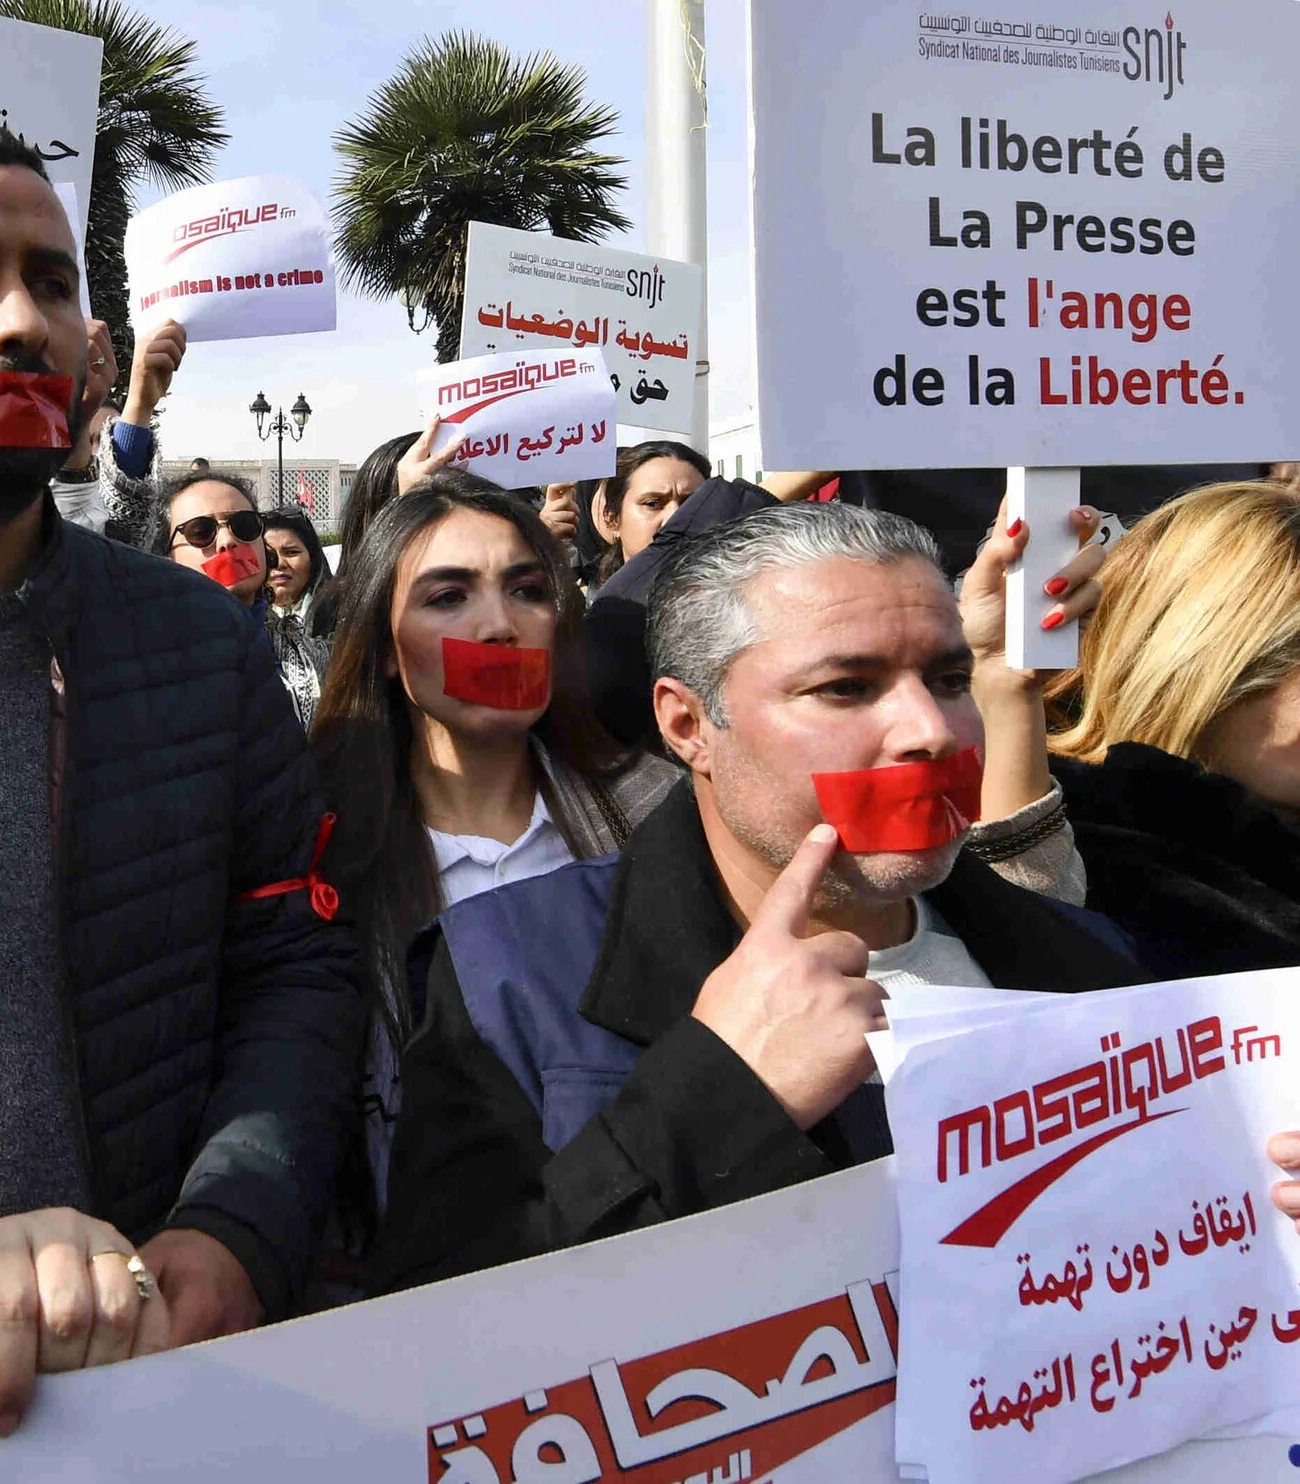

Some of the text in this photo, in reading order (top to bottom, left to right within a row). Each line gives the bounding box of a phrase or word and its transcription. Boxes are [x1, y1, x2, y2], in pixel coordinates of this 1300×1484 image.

[918, 37, 1120, 73] Syndicat National des Journalistes Tunisiens
[1035, 24, 1081, 45] الوطنية
[1122, 10, 1187, 101] snjt
[871, 112, 1226, 183] La liberté de
[928, 196, 1196, 256] La Presse
[216, 275, 232, 292] is
[235, 272, 262, 290] not
[264, 273, 274, 287] a
[626, 264, 665, 309] snjt
[916, 277, 1191, 342] est l'ange
[477, 301, 689, 361] تسوية الوضعيات
[579, 362, 595, 374] fm
[630, 369, 669, 406] حق
[872, 353, 1245, 406] de la Liberté.
[447, 419, 606, 462] لا لتركيع الاعلا
[937, 1015, 1281, 1184] mosaïque fm
[1017, 1191, 1257, 1312] ايقاف دون تهمة
[1089, 1316, 1193, 1414] اختراع
[1204, 1305, 1258, 1370] حين
[969, 1353, 1076, 1433] التهمة
